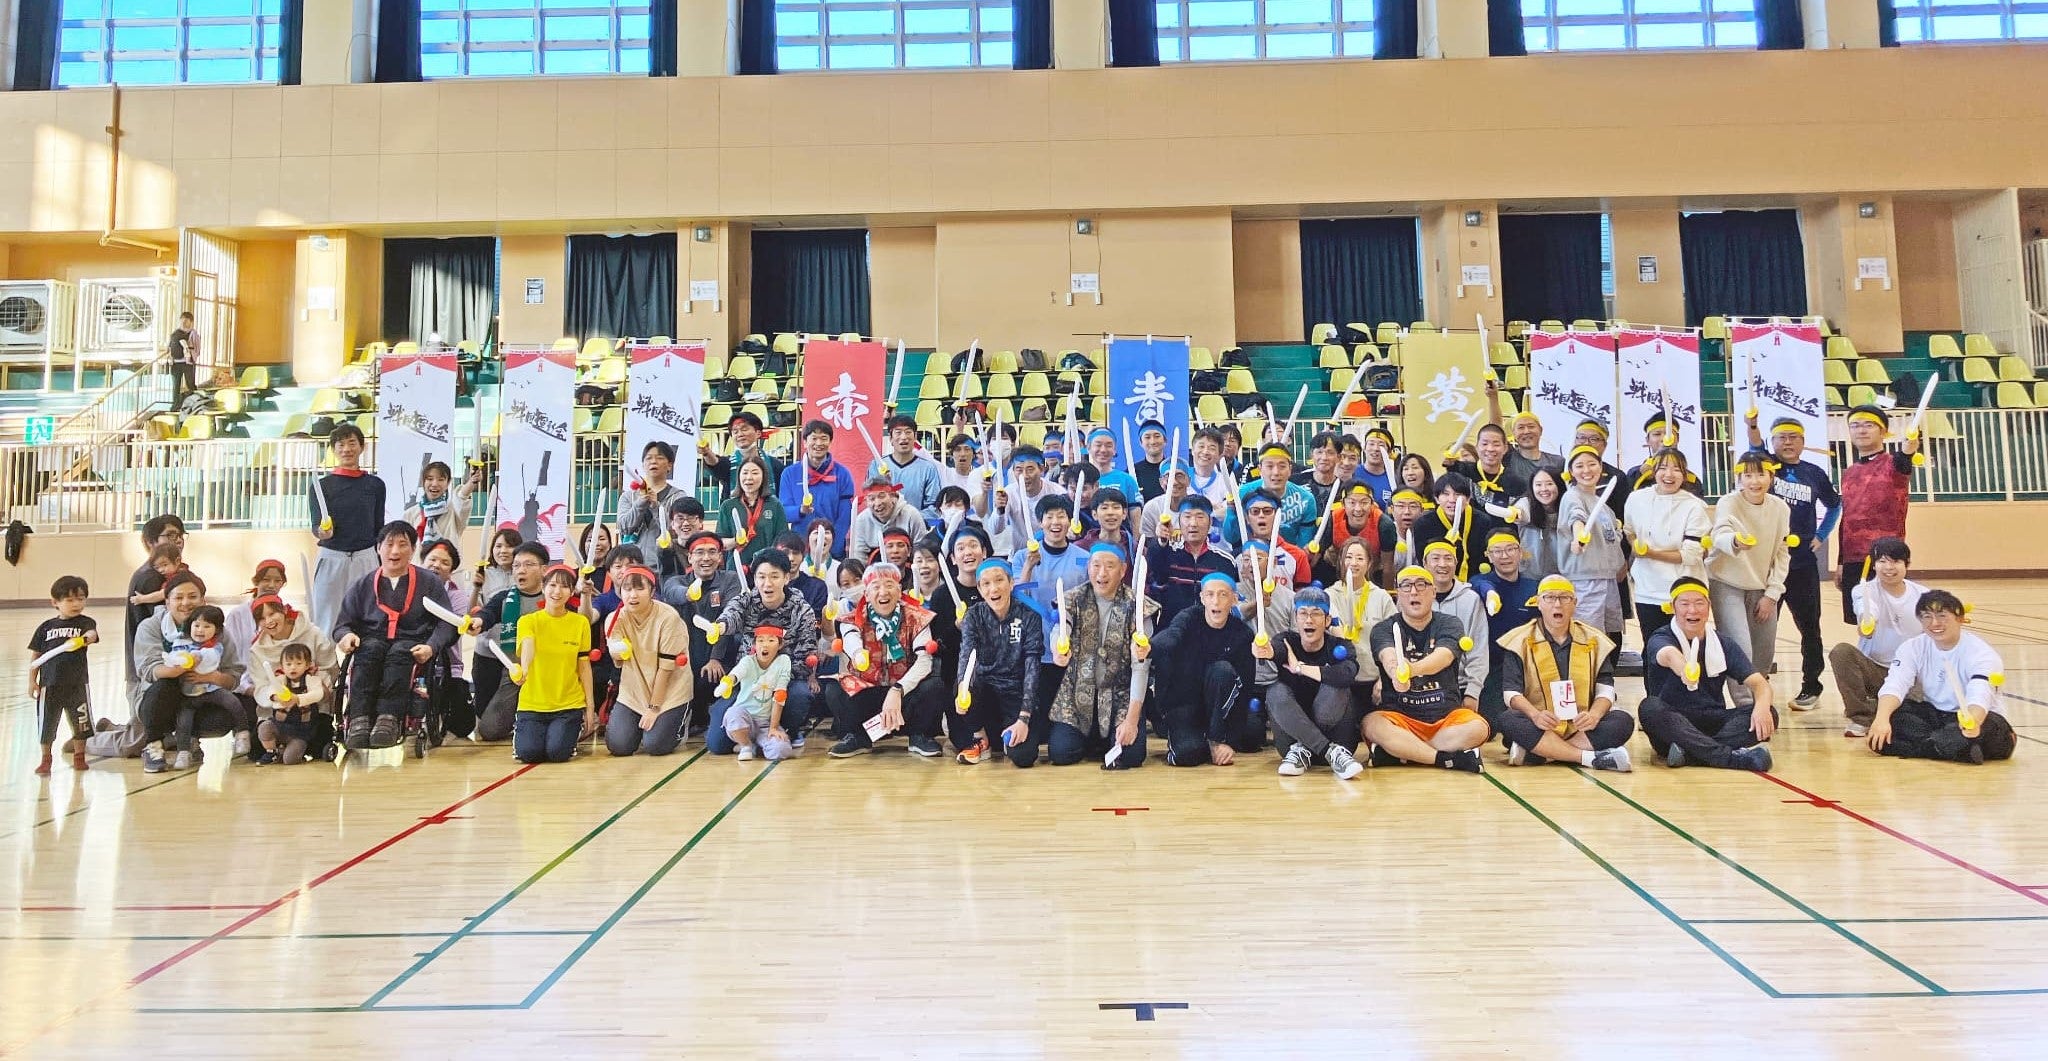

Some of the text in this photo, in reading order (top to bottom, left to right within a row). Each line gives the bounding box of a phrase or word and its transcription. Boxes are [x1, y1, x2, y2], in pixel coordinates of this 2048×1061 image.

[815, 372, 869, 430] 赤
[1123, 370, 1175, 426] 青
[1418, 366, 1475, 424] 黄
[45, 627, 81, 642] EDWIN
